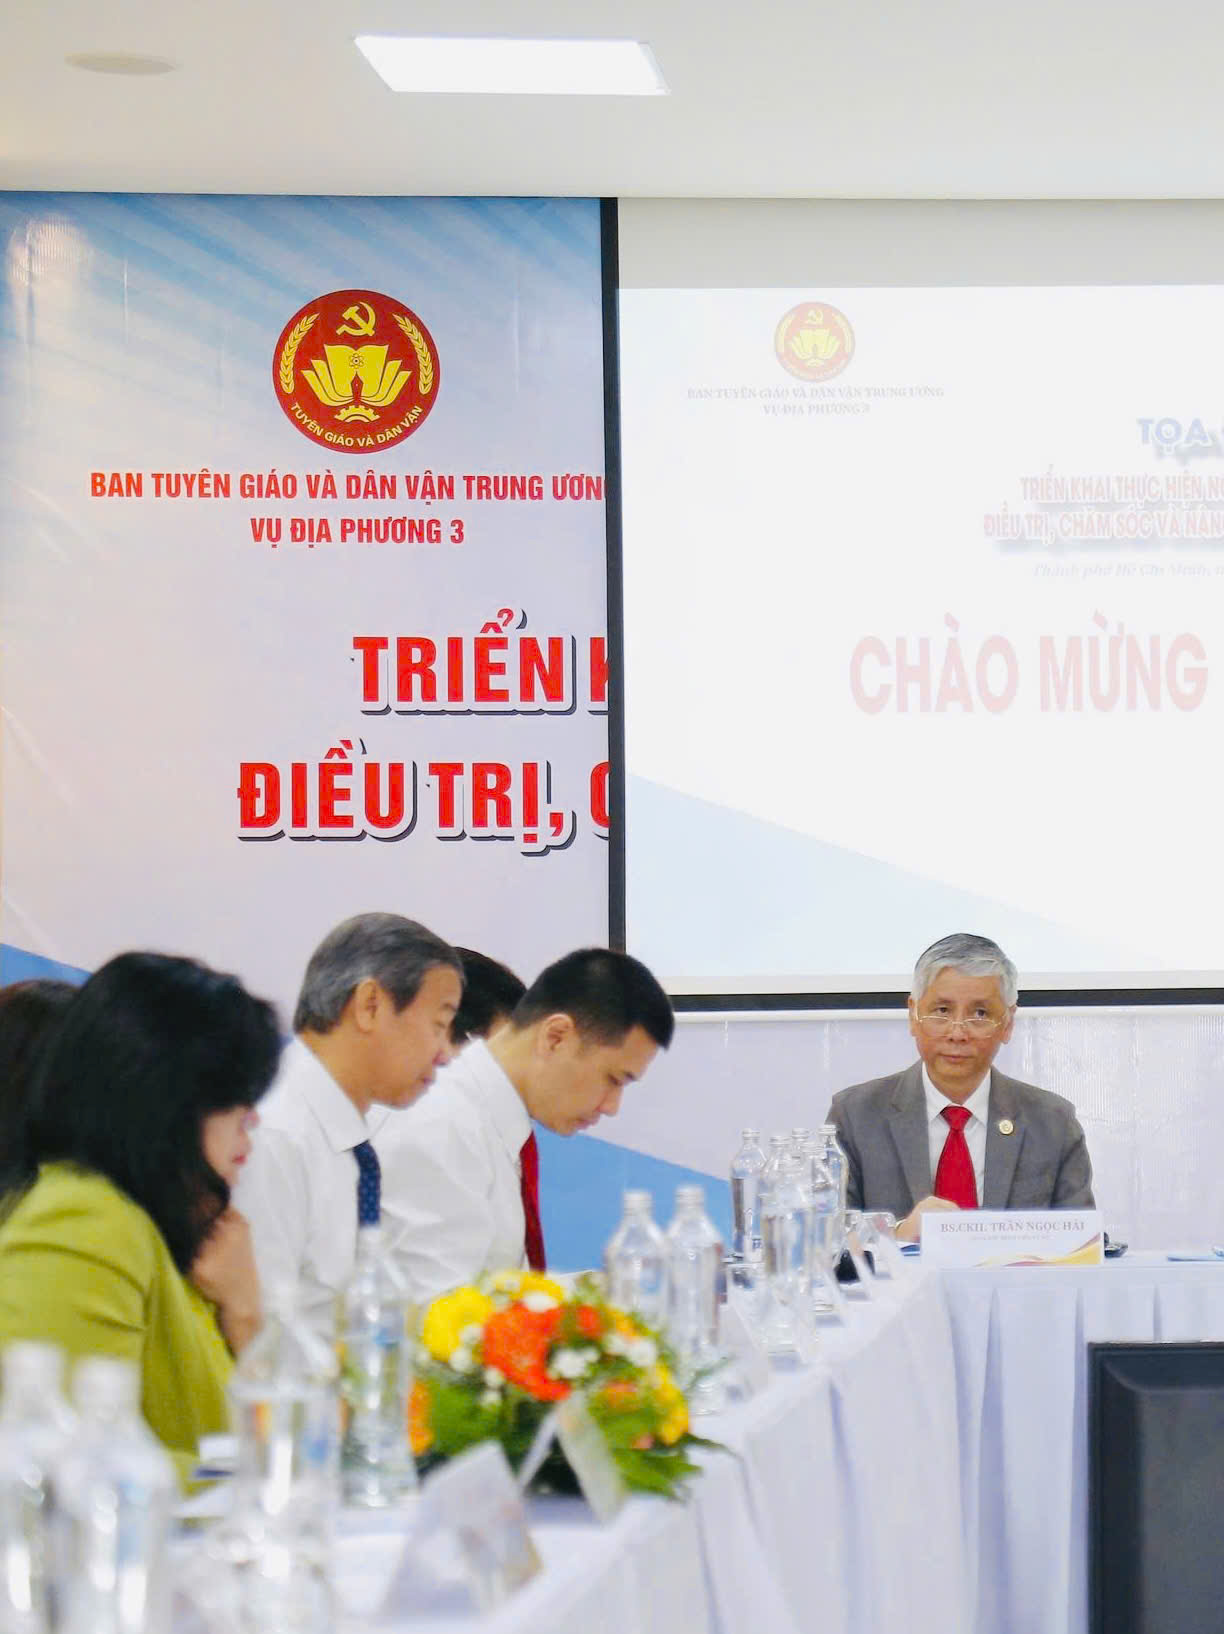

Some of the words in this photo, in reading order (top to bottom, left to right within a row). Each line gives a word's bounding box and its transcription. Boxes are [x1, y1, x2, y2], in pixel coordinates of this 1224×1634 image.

[290, 401, 323, 437] TUYÊN
[325, 430, 354, 447] GIÁO
[356, 434, 375, 447] VÀ
[377, 425, 403, 443] DÂN
[401, 405, 424, 429] VẬN
[90, 472, 143, 498] BAN
[151, 468, 231, 498] TUYÊN
[239, 469, 298, 499] GIÁO
[305, 469, 338, 499] VÀ
[345, 469, 397, 500] DÂN
[404, 469, 455, 506] VẬN
[462, 475, 544, 501] TRUNG
[552, 473, 607, 501] ƯƠN
[250, 517, 282, 549] VỤ
[289, 517, 333, 549] ĐỊA
[340, 516, 442, 544] PHƯƠNG
[449, 519, 465, 544] 3
[352, 607, 567, 706] TRIỂN
[849, 611, 1020, 714] CHÀO
[1039, 608, 1209, 713] MỪNG
[236, 739, 407, 831] ĐIỀU
[428, 761, 566, 845] TRỊ,
